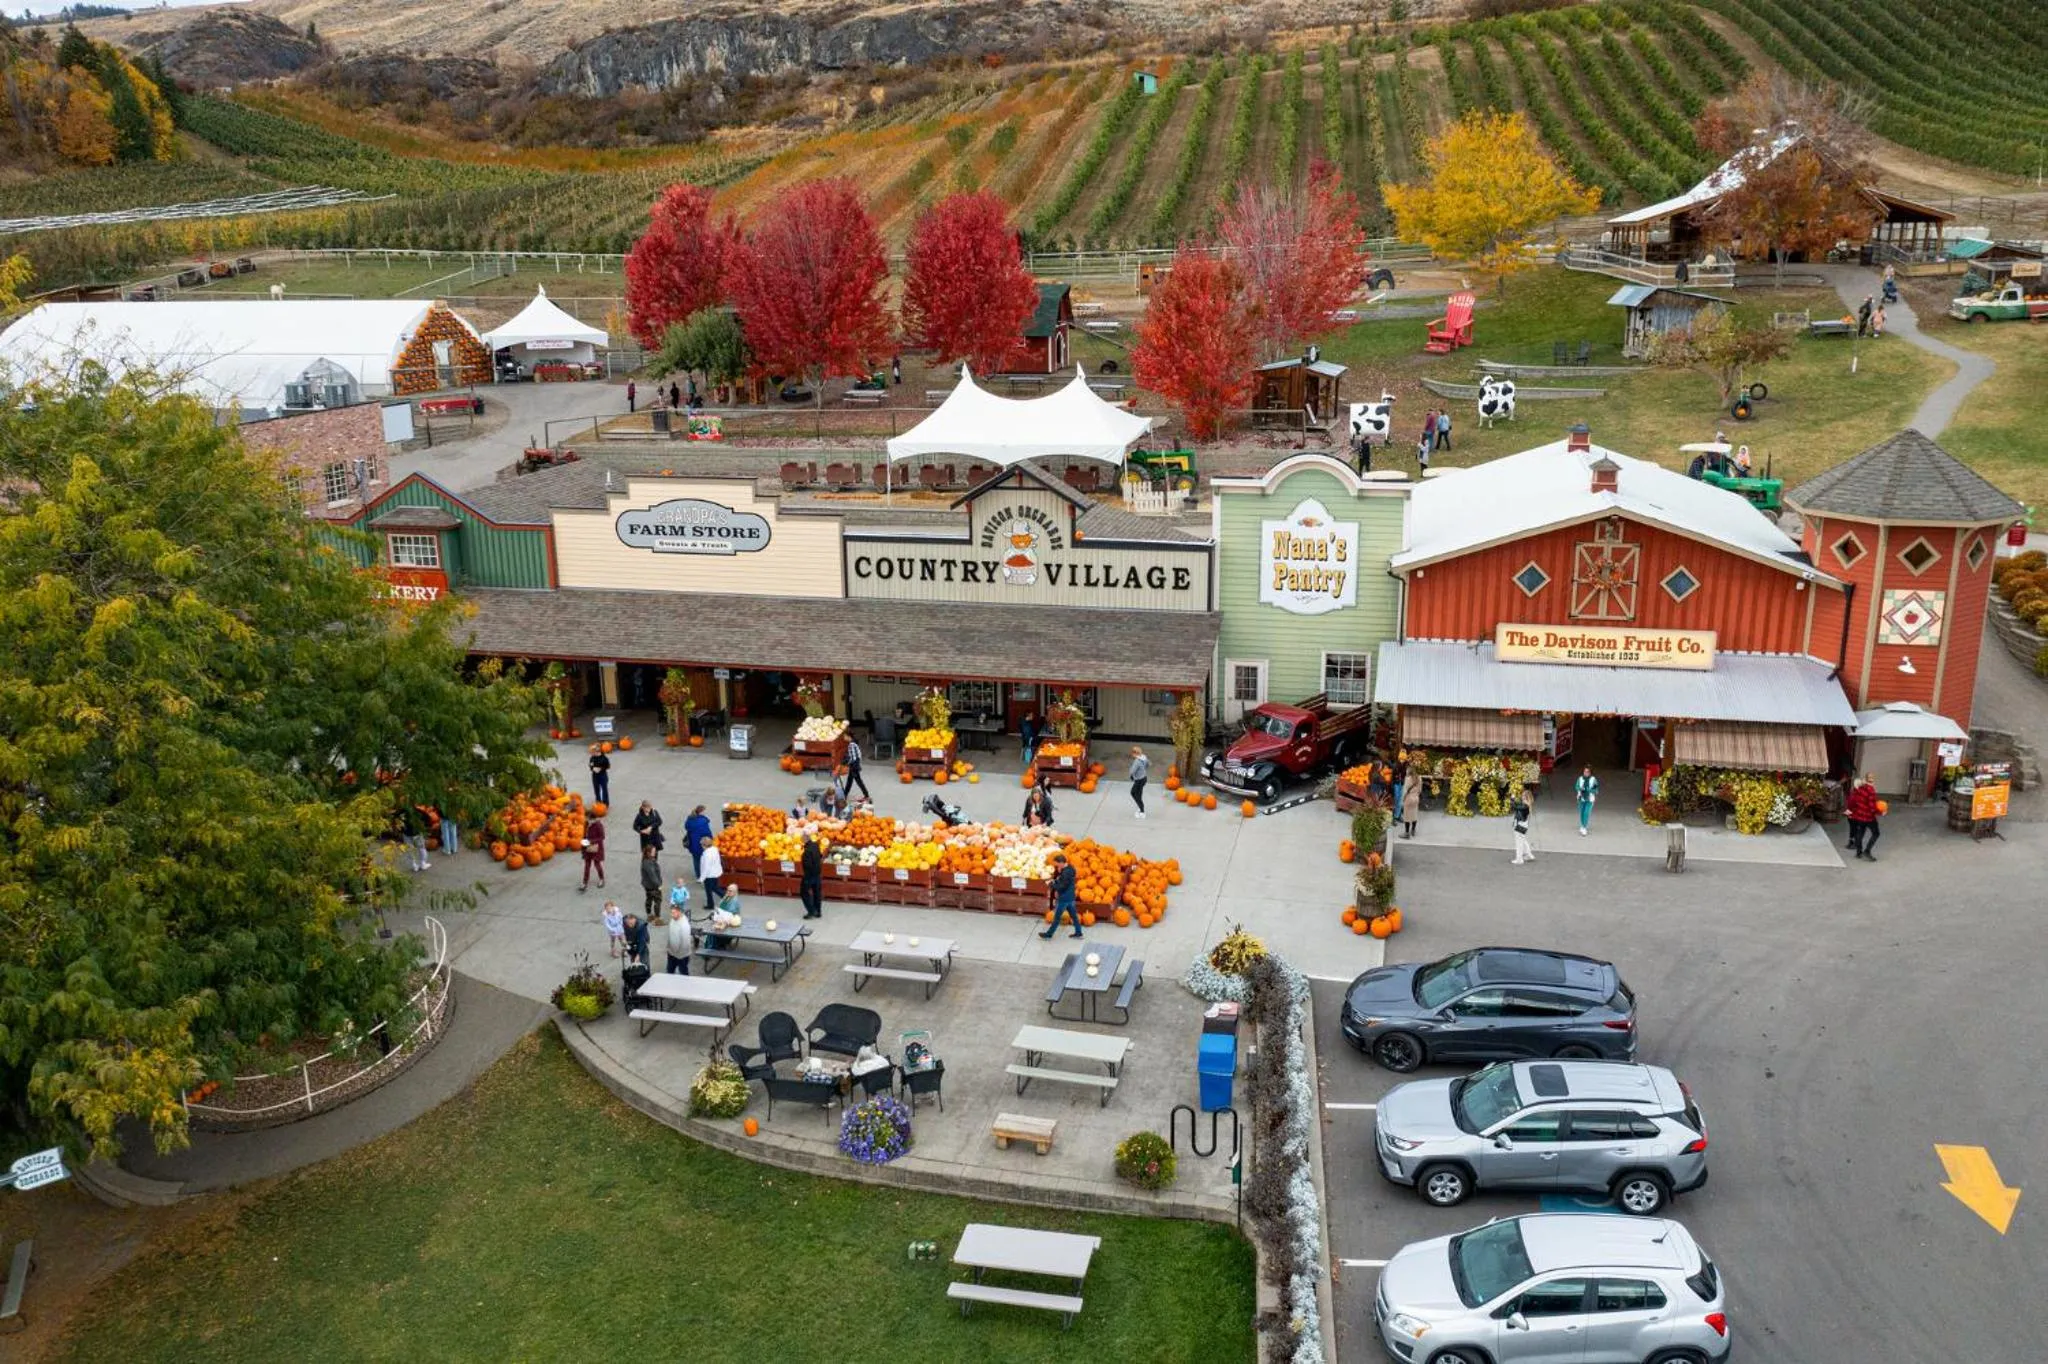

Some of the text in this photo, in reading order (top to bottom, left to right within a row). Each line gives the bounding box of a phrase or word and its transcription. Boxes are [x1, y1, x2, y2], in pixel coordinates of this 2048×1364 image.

[656, 507, 729, 527] GRANDPA'S
[981, 505, 1064, 551] DAVISON ORCHARDS
[629, 523, 761, 539] FARM STORE
[1273, 530, 1347, 562] Nana's
[854, 556, 1192, 591] COUNTRY VILLAGE
[1273, 562, 1347, 599] Pantry
[372, 585, 439, 601] KERY
[1506, 630, 1705, 654] The Davison Fruit Co.
[1567, 649, 1616, 660] Established
